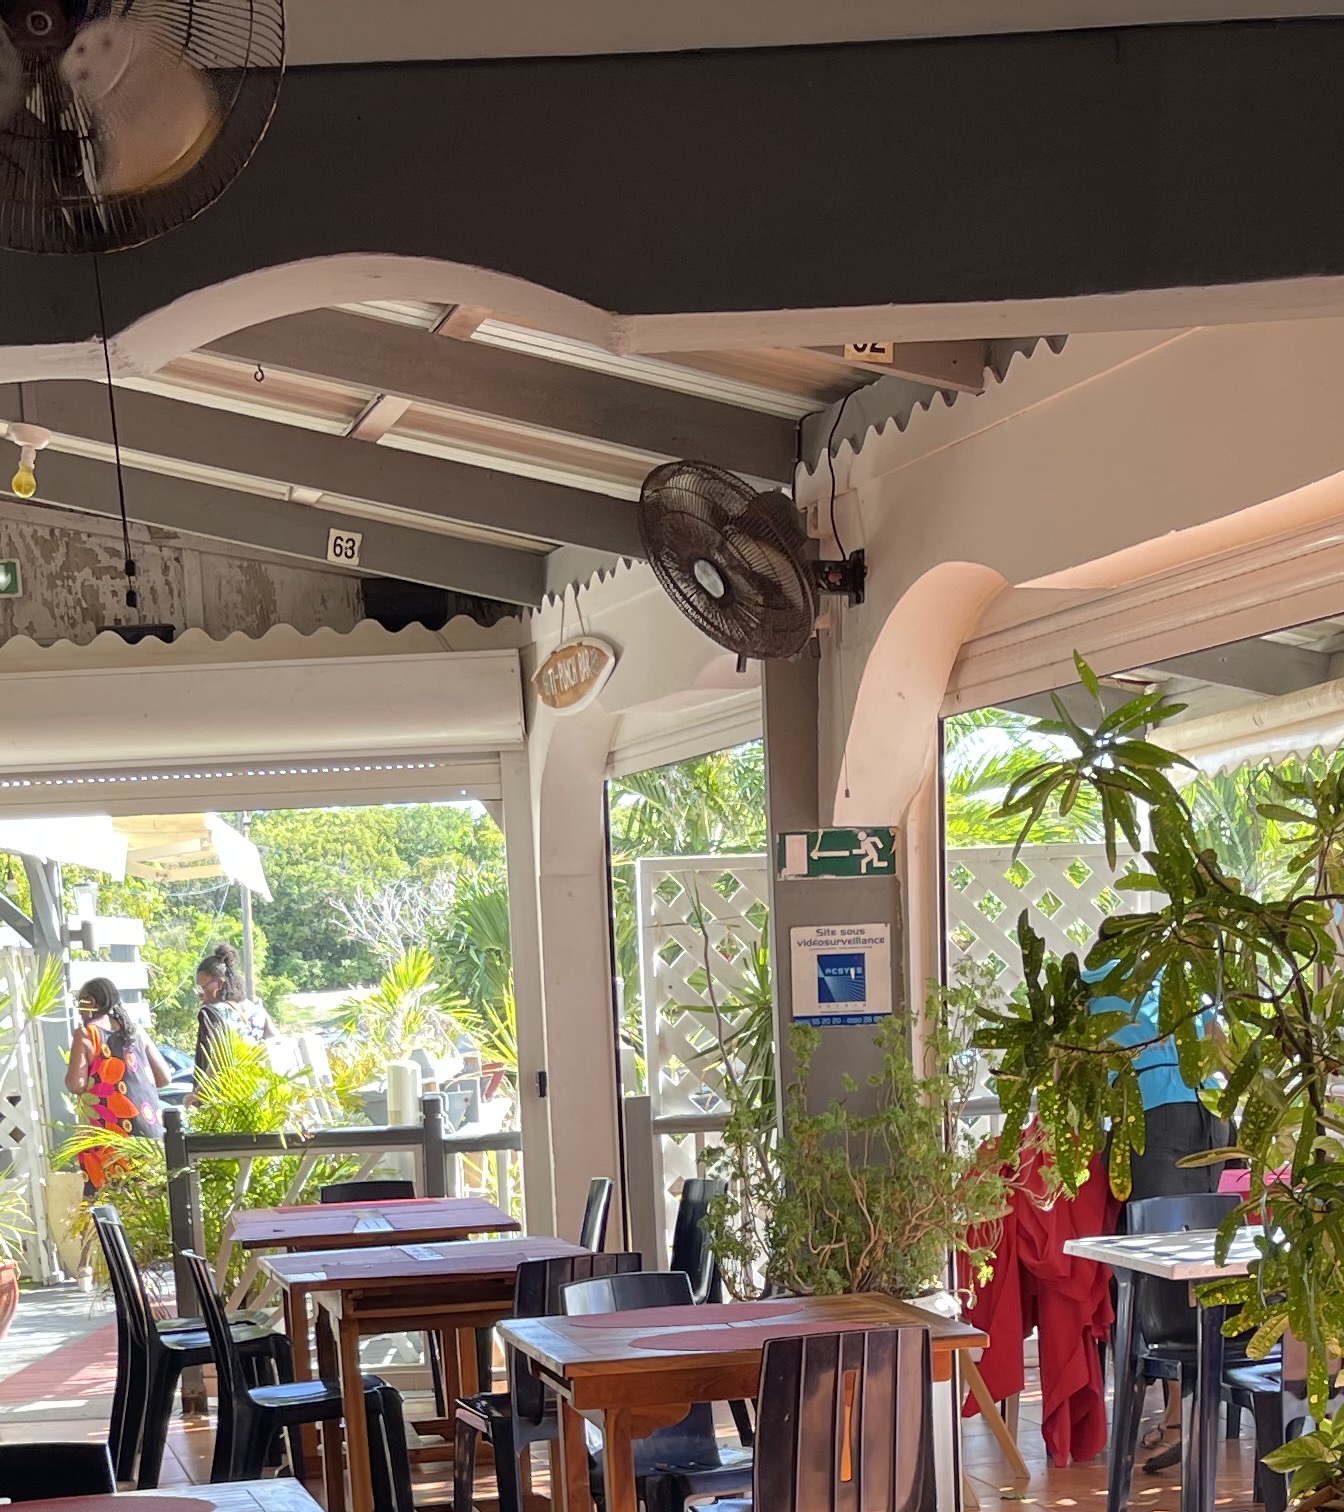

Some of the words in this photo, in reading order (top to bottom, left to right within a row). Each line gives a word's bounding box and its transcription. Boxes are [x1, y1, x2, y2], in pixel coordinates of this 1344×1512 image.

[333, 536, 356, 559] 63
[816, 928, 837, 937] Site
[840, 927, 865, 936] sous
[797, 937, 885, 948] vidéosurveillance
[824, 966, 863, 976] ACSYS
